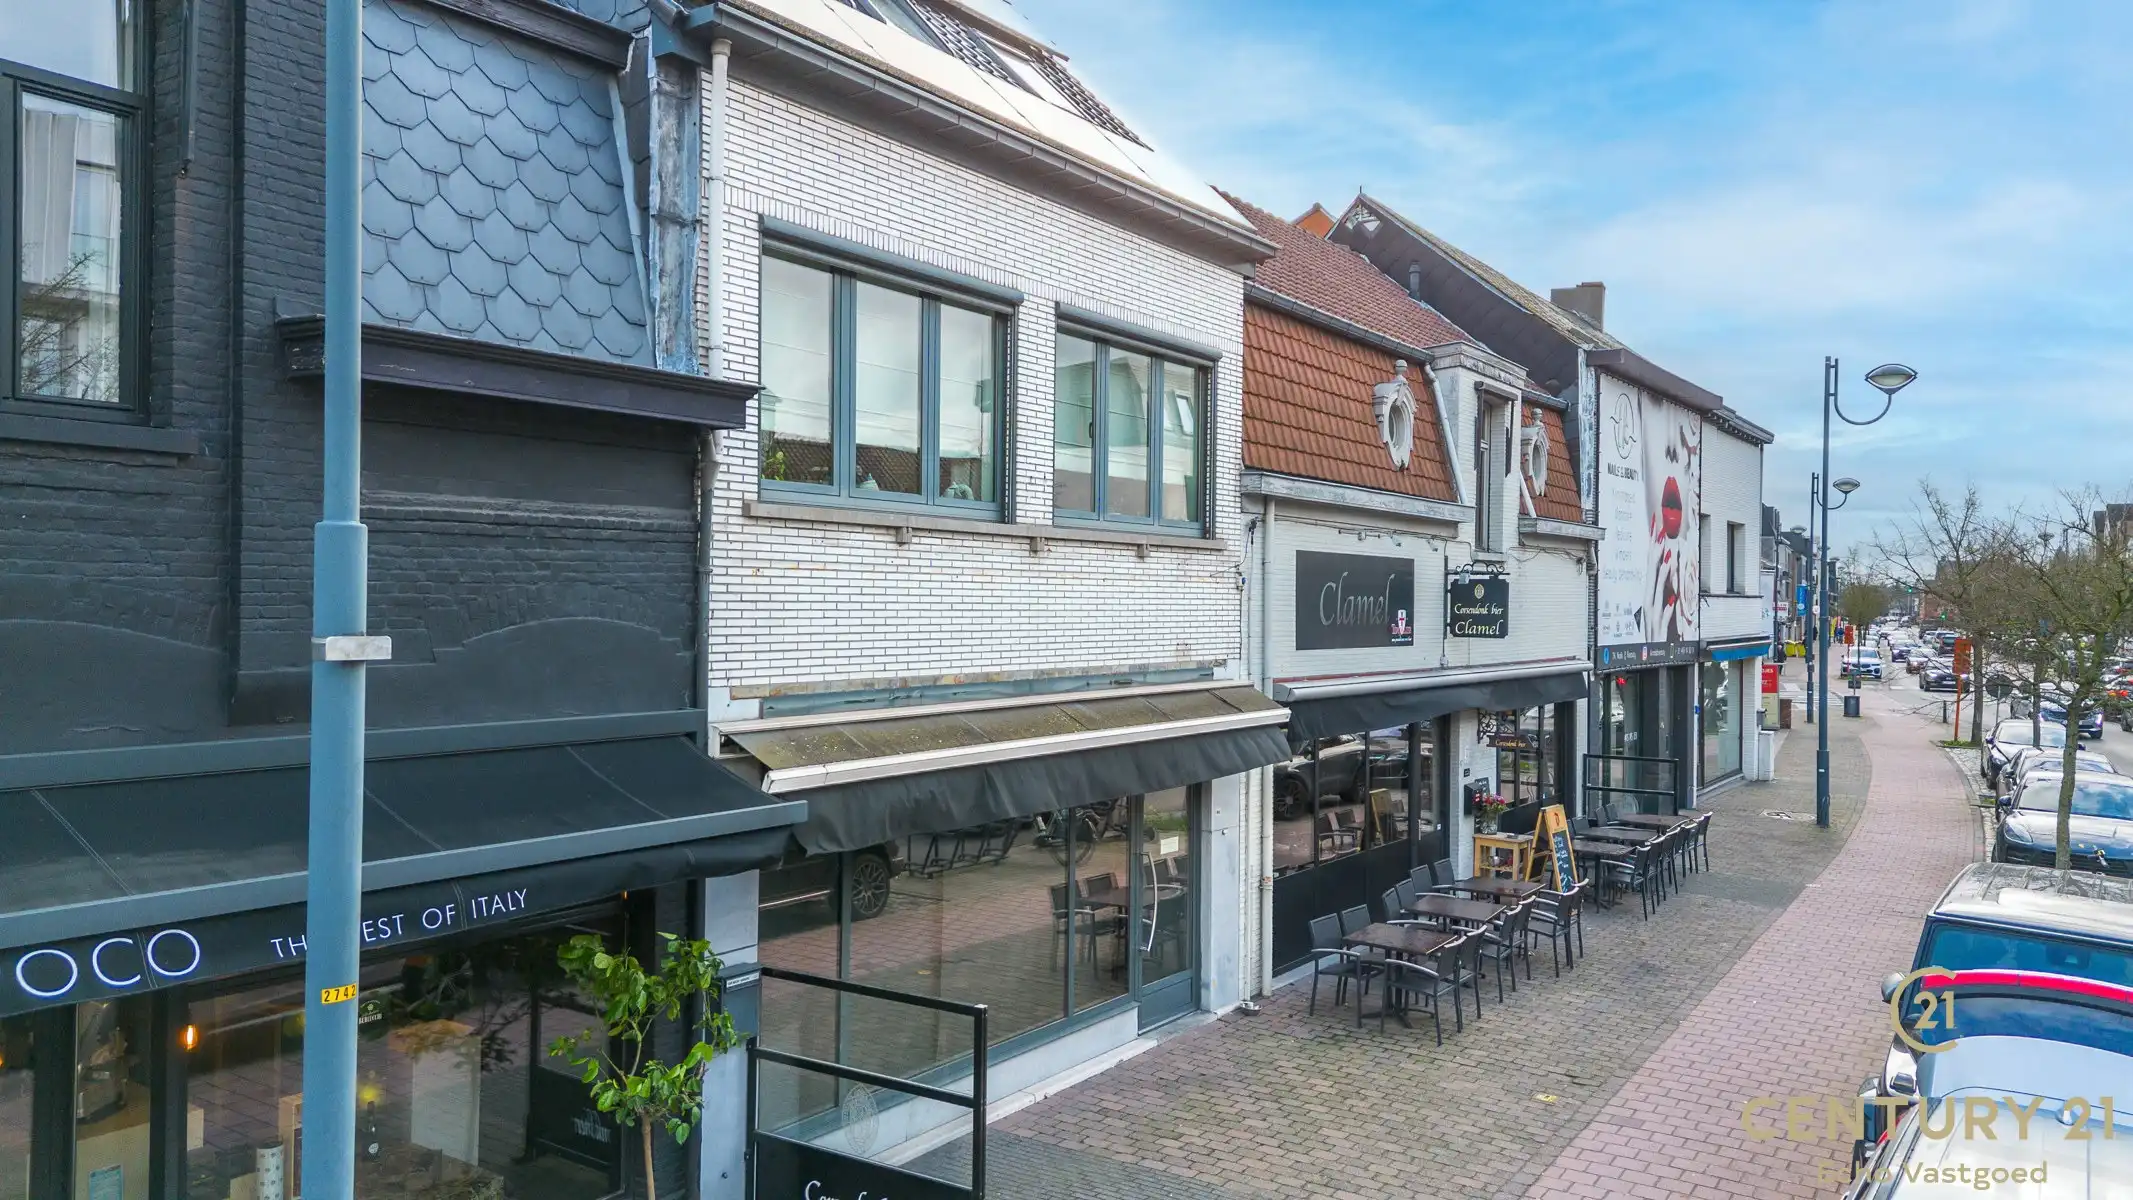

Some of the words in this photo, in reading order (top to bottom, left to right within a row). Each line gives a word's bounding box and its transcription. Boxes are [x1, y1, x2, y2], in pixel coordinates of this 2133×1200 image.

[1319, 571, 1396, 626] Clamel
[1454, 602, 1489, 616] Corsendonk
[1490, 603, 1504, 616] bier
[1455, 618, 1504, 636] Clamel
[0, 927, 201, 998] OCO
[270, 933, 308, 959] TH
[362, 913, 404, 943] EST
[422, 903, 457, 930] OF
[471, 888, 528, 920] ITALY
[323, 984, 356, 1003] 2742
